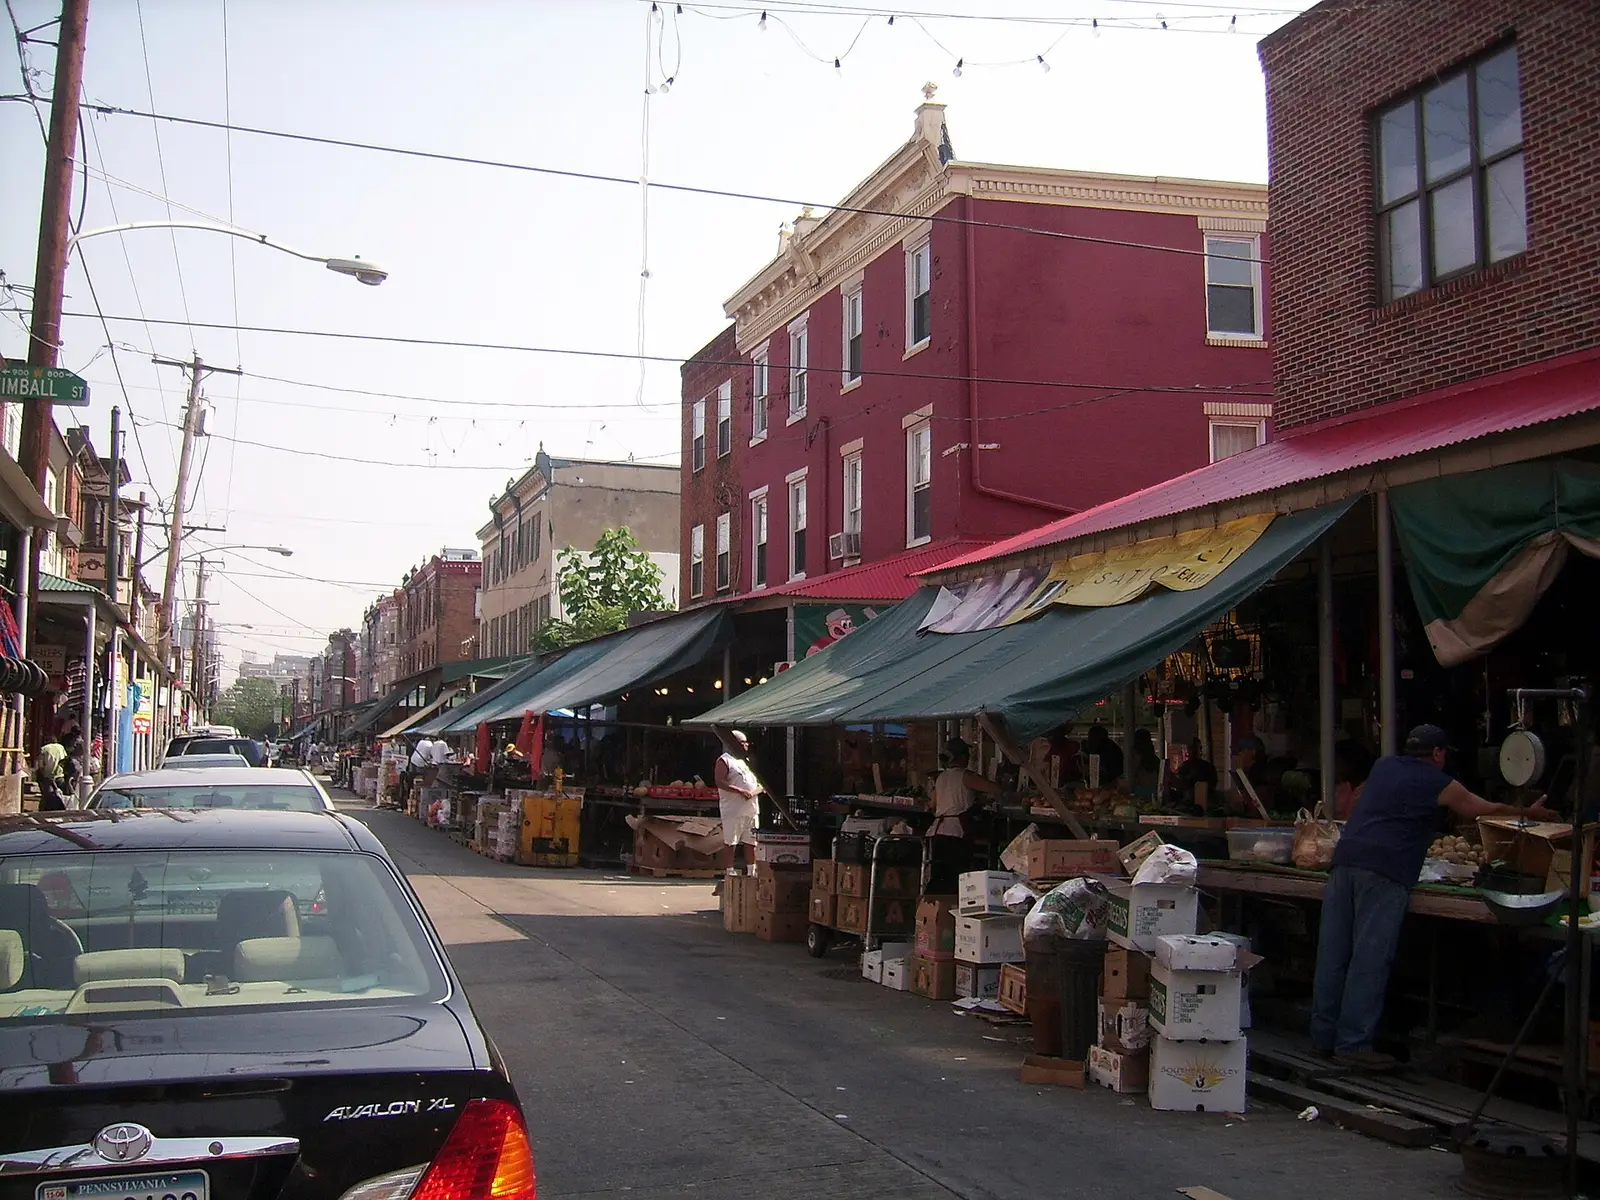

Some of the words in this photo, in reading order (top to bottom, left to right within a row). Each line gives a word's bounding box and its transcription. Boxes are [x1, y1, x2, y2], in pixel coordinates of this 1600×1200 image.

[12, 368, 29, 376] 900
[0, 377, 58, 397] IMBALL
[71, 386, 84, 398] ST
[323, 1100, 421, 1121] AVALON
[427, 1097, 455, 1112] XL
[78, 1179, 167, 1195] PENNSYLVANIA
